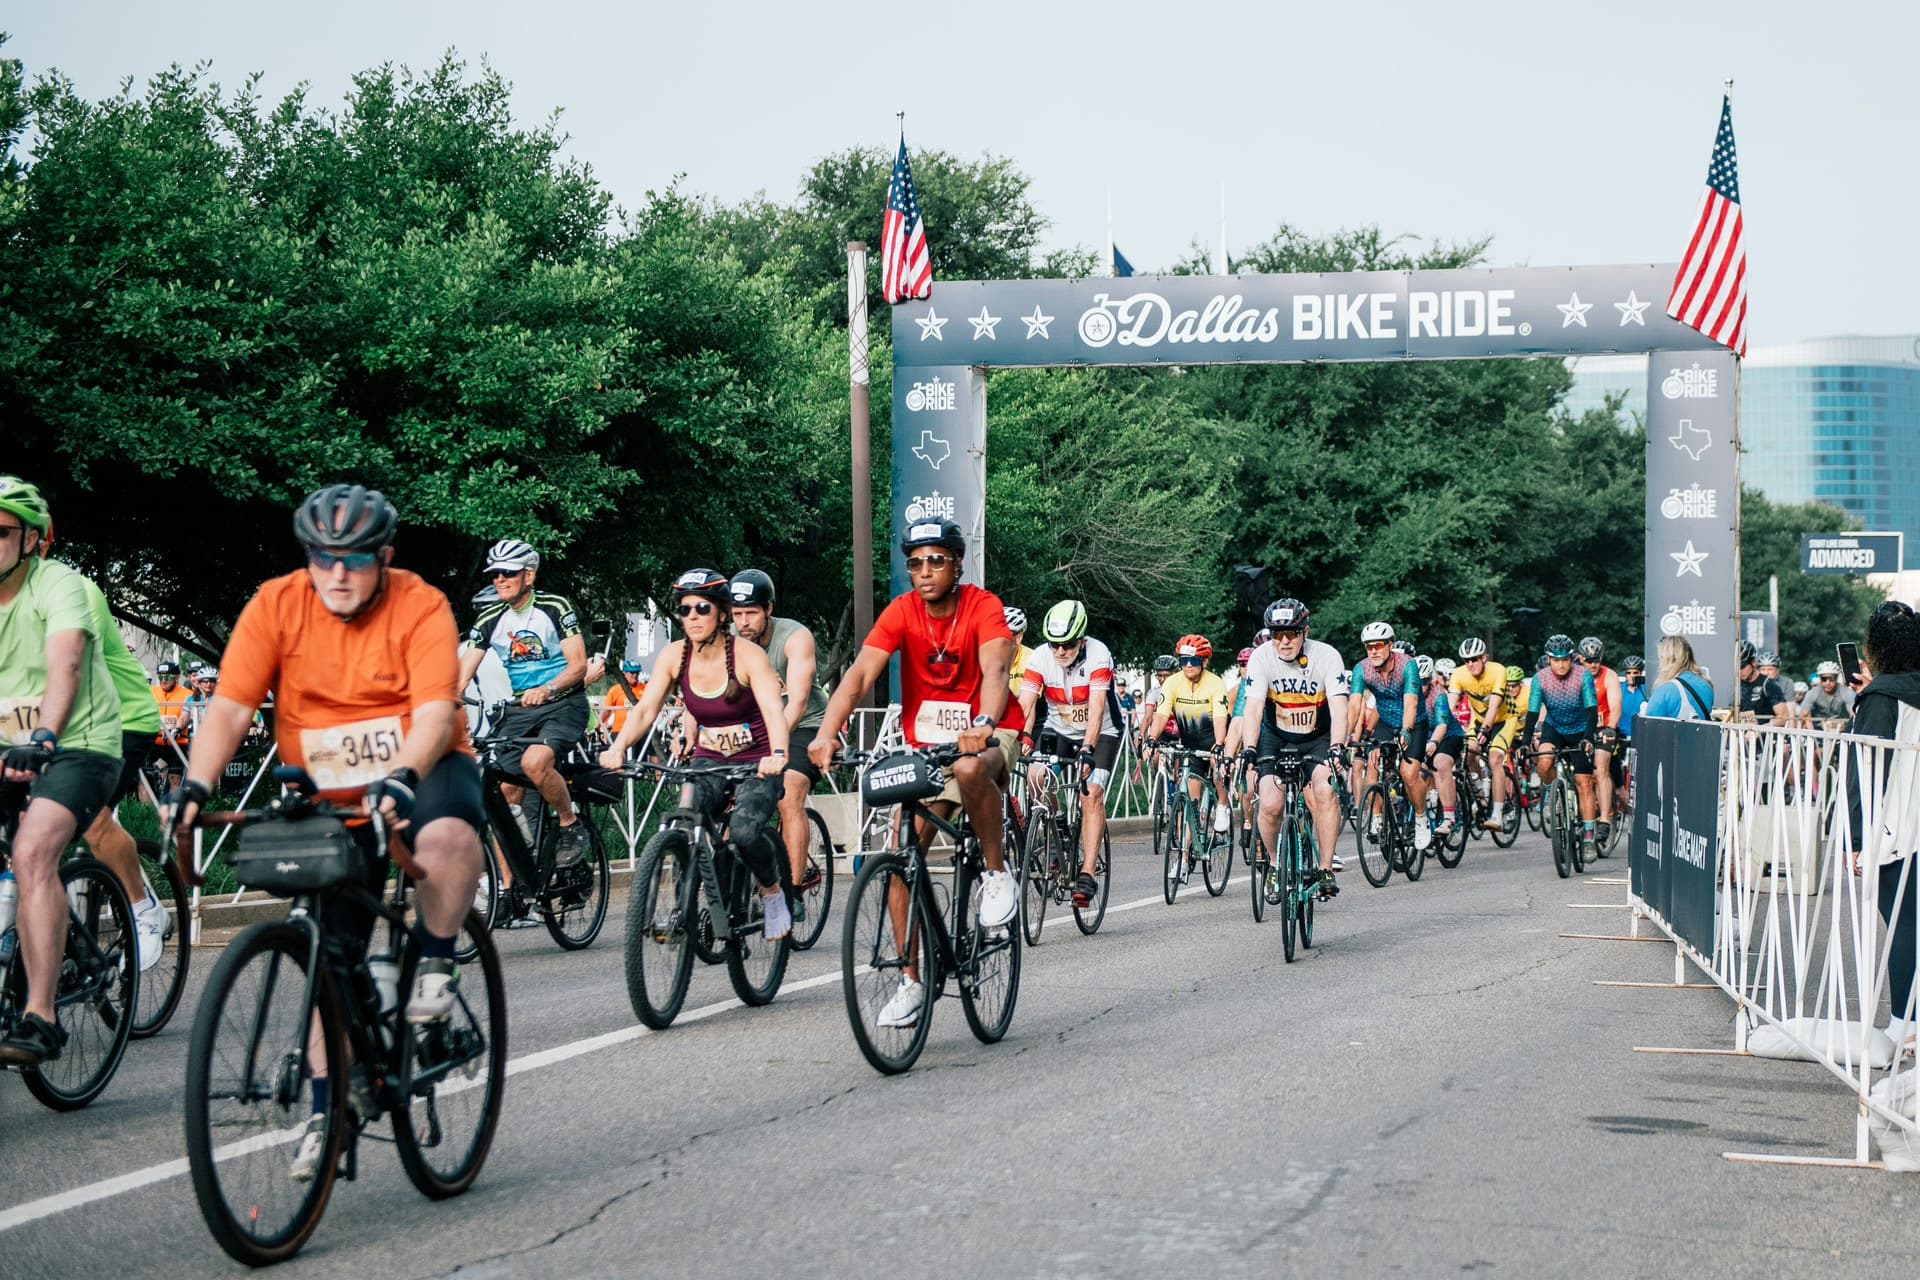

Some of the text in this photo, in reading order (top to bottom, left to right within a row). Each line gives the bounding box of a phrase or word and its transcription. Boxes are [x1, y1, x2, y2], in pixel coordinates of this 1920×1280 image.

[1117, 293, 1279, 347] Dallas
[1293, 294, 1397, 340] BIKE
[1684, 369, 1717, 383] BIKE
[926, 383, 955, 396] BIKE
[1684, 383, 1718, 398] RIDE
[926, 396, 956, 410] RIDE
[925, 497, 955, 510] BIKE
[1684, 489, 1717, 503] BIKE
[1684, 503, 1718, 518] RIDE
[1808, 549, 1875, 568] ADVANCED
[1683, 606, 1716, 620] BIKE
[1683, 620, 1717, 635] RIDE
[1272, 679, 1318, 696] TEXAS
[936, 709, 968, 731] 4655
[1291, 711, 1315, 726] 1107
[342, 729, 399, 767] 3451
[225, 762, 243, 777] KEEP
[870, 771, 917, 790] BIKING
